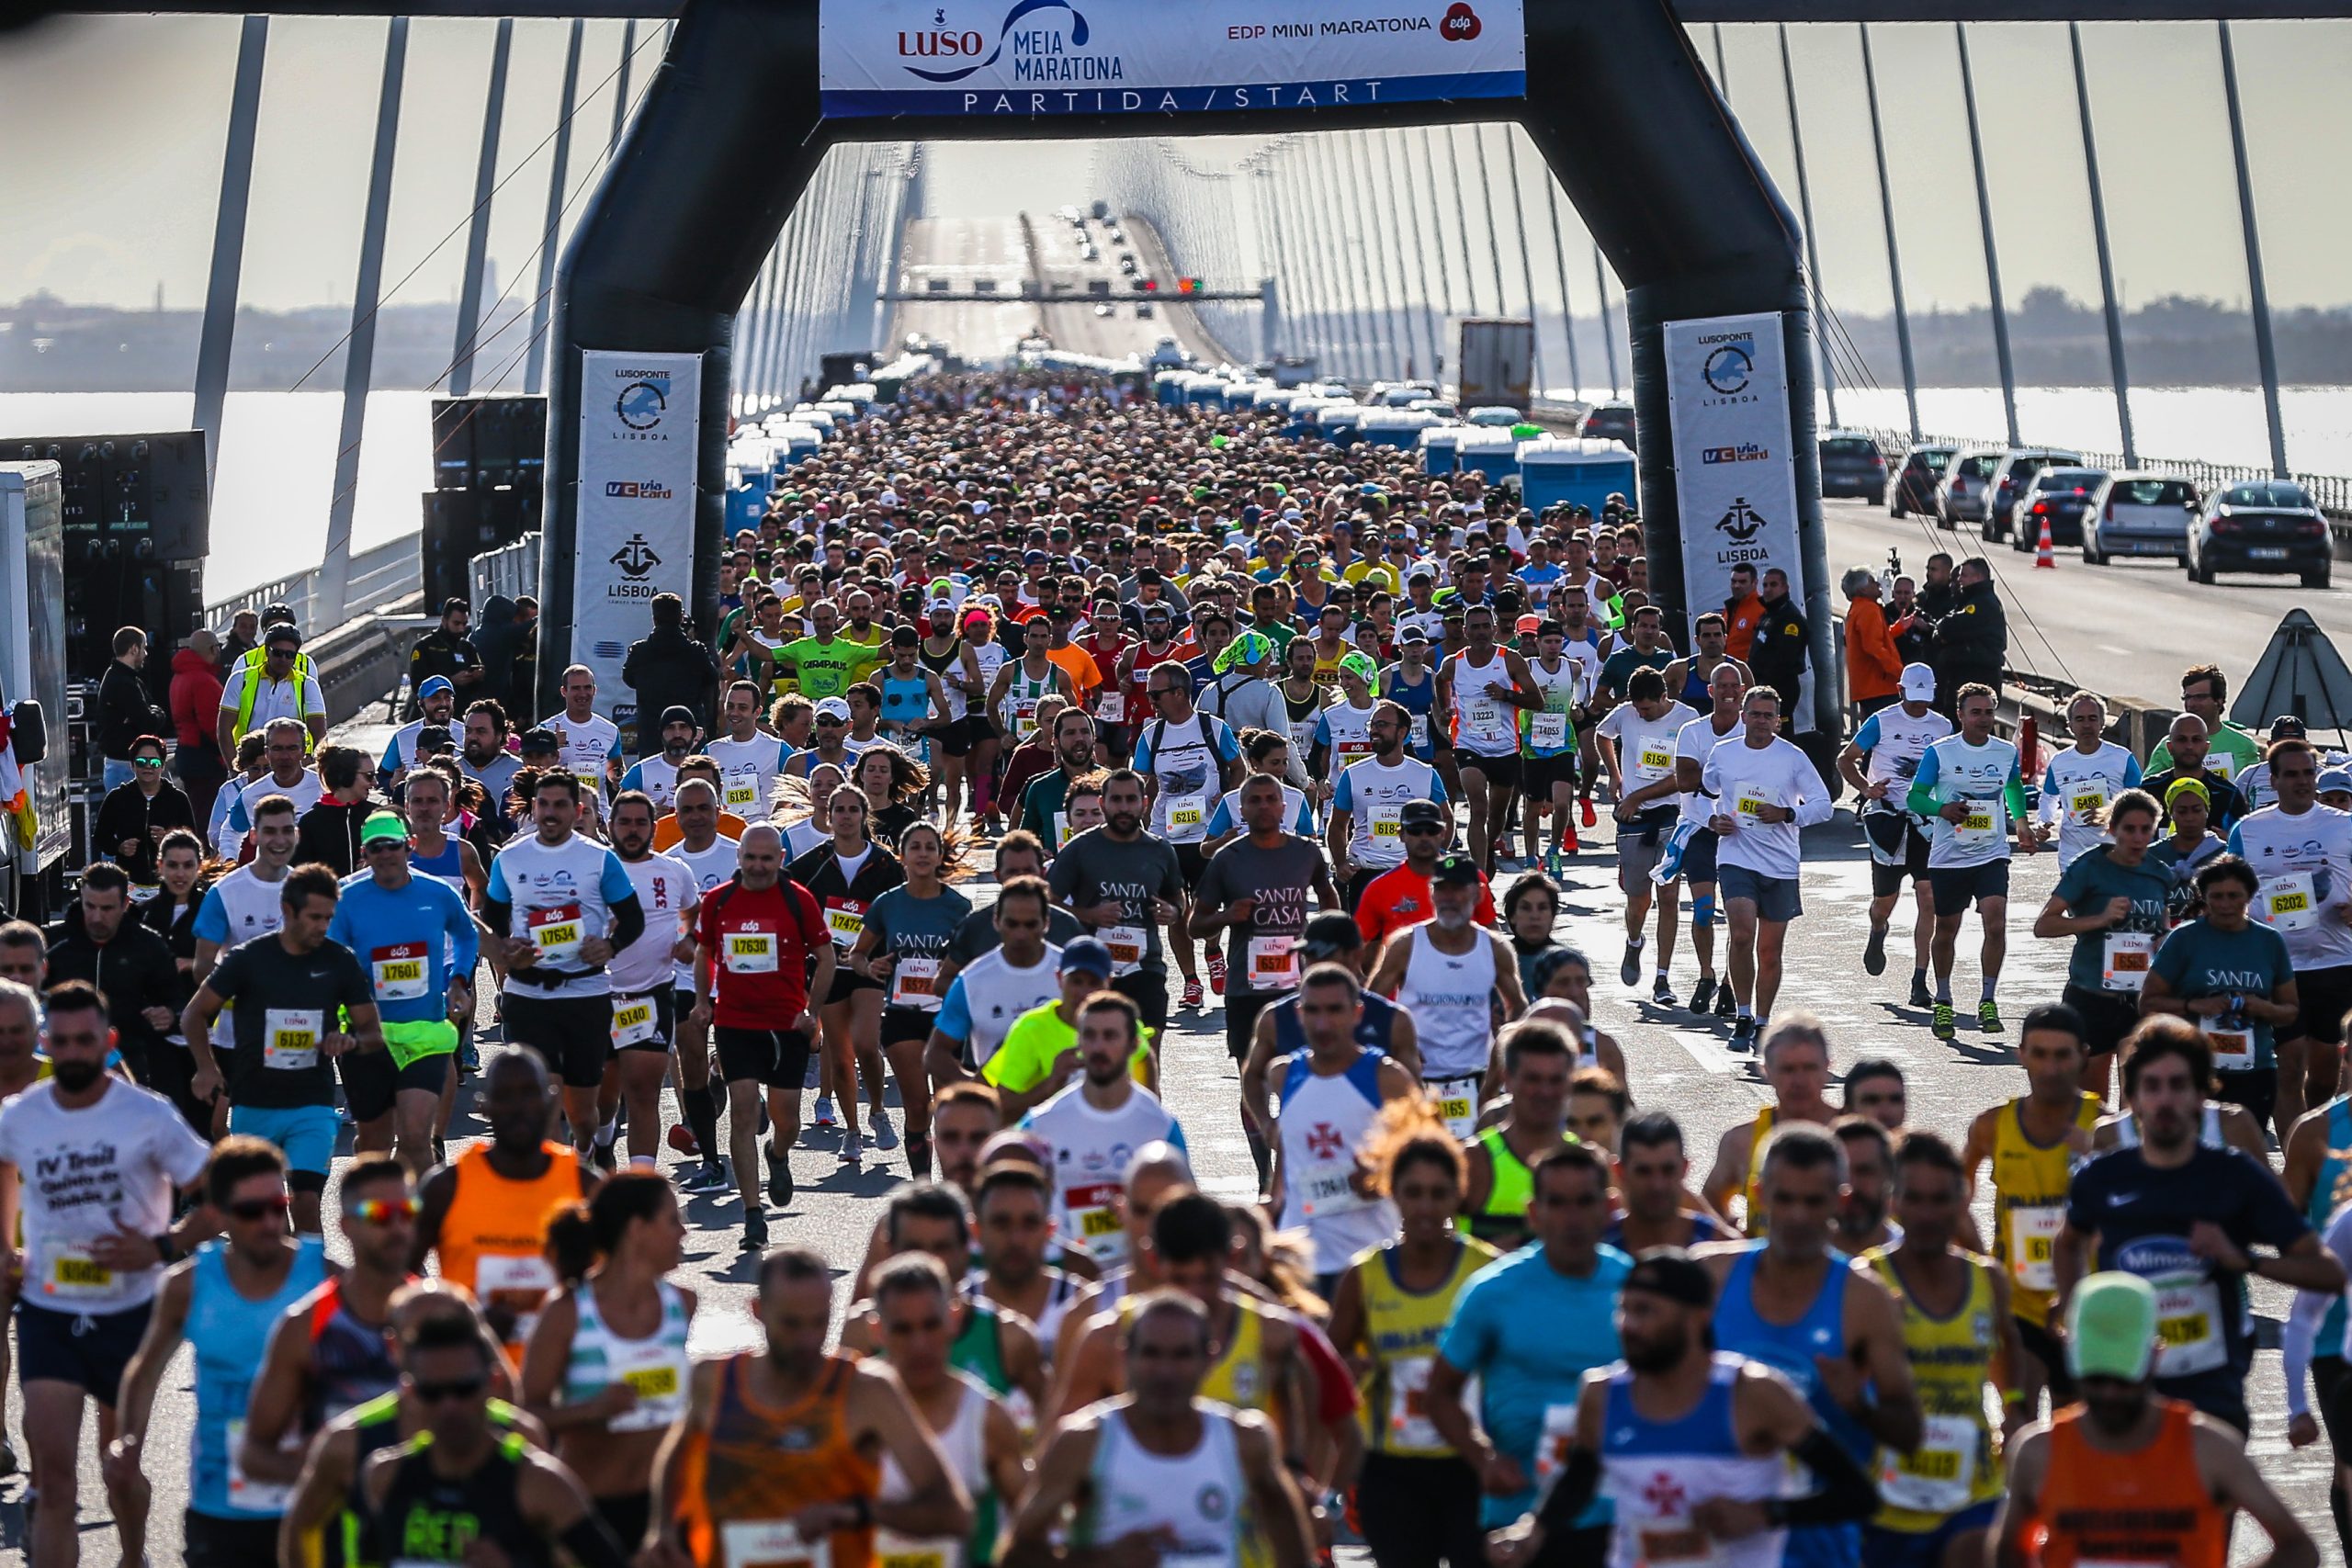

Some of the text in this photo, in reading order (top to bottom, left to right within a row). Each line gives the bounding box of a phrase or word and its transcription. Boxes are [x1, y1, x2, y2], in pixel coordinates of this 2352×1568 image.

[1227, 17, 1431, 39] EDP MINI MARATONA
[1449, 15, 1471, 29] edp
[898, 30, 983, 56] LUSO
[1013, 30, 1063, 55] MEIA
[1014, 56, 1123, 81] MARATONA
[1698, 331, 1754, 344] LUSOPONTE
[615, 369, 671, 379] LUSOPONTE
[1702, 395, 1759, 407] LISBOA
[613, 432, 669, 442] LISBOA
[1736, 442, 1758, 454] via
[1737, 448, 1769, 462] card
[640, 479, 662, 491] via
[640, 489, 672, 499] card
[1717, 547, 1770, 564] LISBOA
[607, 584, 659, 598] LISBOA
[1472, 711, 1495, 721] 13223
[1538, 725, 1560, 736] 14055
[1645, 753, 1667, 765] 6150
[729, 790, 751, 803] 6182
[1747, 788, 1766, 798] LUSO
[2076, 785, 2095, 794] LUSO
[2076, 795, 2100, 809] 6488
[1176, 811, 1197, 823] 6216
[1966, 817, 1989, 829] 6489
[653, 877, 668, 909] 3XS
[1100, 881, 1148, 899] SANTA
[2275, 882, 2298, 892] LUSO
[1254, 886, 1304, 905] SANTA
[842, 899, 859, 914] edp
[2275, 895, 2304, 912] 6202
[545, 909, 564, 922] edp
[831, 913, 862, 932] 17472
[1254, 906, 1302, 926] CASA
[741, 919, 760, 933] edp
[540, 926, 576, 944] 17634
[896, 931, 944, 949] SANTA
[734, 939, 767, 953] 17630
[1264, 943, 1285, 952] LUSO
[2123, 940, 2143, 948] LUSO
[390, 944, 411, 959] edp
[910, 964, 930, 973] LUSO
[1261, 957, 1286, 971] 6571
[384, 964, 420, 980] 17601
[2207, 969, 2264, 989] SANTA
[284, 1017, 308, 1025] LUSO
[619, 1007, 646, 1026] 6140
[279, 1032, 311, 1048] 6137
